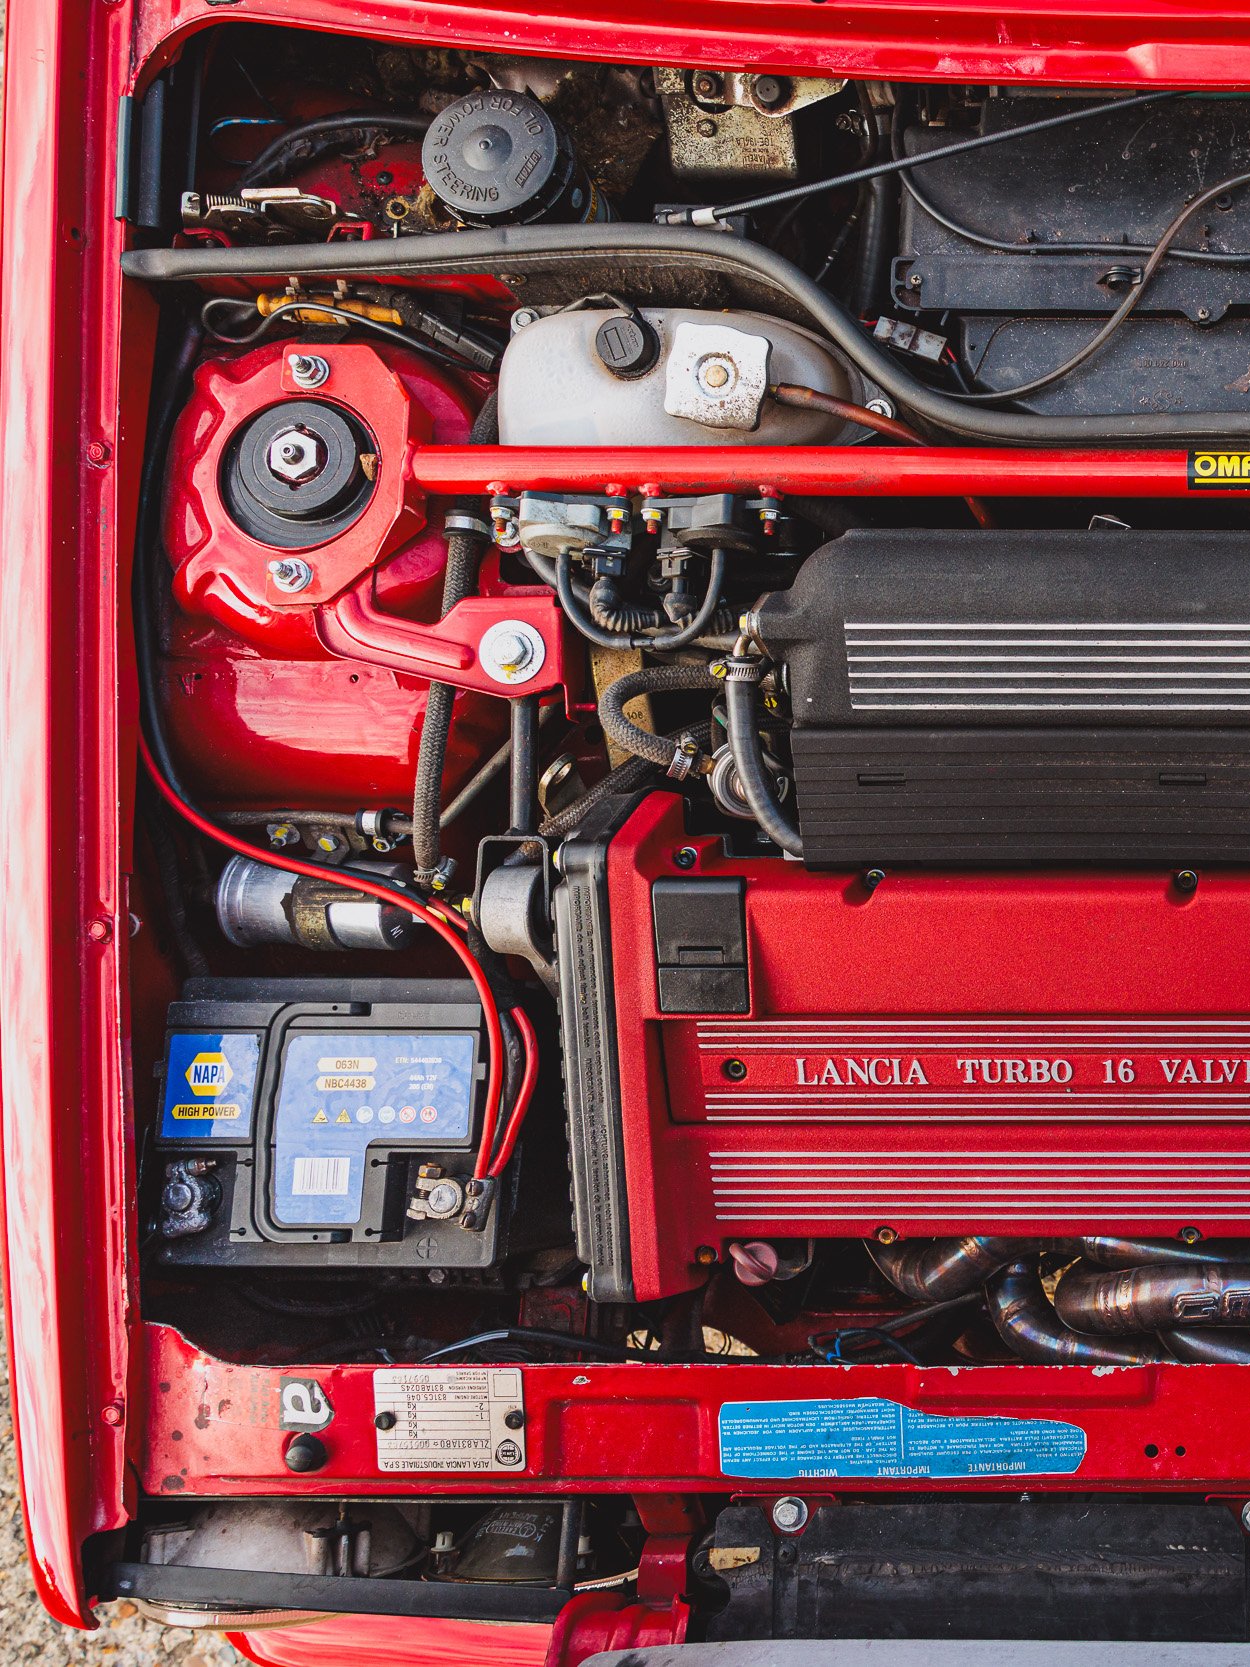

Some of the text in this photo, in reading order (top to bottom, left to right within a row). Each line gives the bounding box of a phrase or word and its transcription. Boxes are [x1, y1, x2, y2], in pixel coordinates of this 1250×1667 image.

[434, 97, 544, 202] OIL FOR POWER STEERING
[335, 1060, 360, 1070] 063N
[193, 1065, 226, 1084] NAPA
[796, 1058, 930, 1086] LANCIA
[957, 1058, 1074, 1085] TURBO
[1102, 1059, 1136, 1085] 16
[324, 1079, 368, 1089] NBC4438
[178, 1107, 236, 1117] HIGH POWER
[400, 1384, 444, 1392] 831AB024S
[406, 1393, 447, 1401] 831C5.046
[407, 1402, 417, 1411] Kg
[407, 1411, 417, 1420] Kg
[408, 1421, 418, 1430] Kg
[408, 1430, 418, 1439] Kg
[402, 1460, 444, 1469] INDUSTRIALE
[445, 1460, 471, 1470] LANCIA
[472, 1460, 490, 1470] ALFA
[967, 1462, 1026, 1472] IMPORTANTE
[798, 1468, 838, 1477] WICHTIG
[876, 1465, 930, 1475] IMPORTANT
